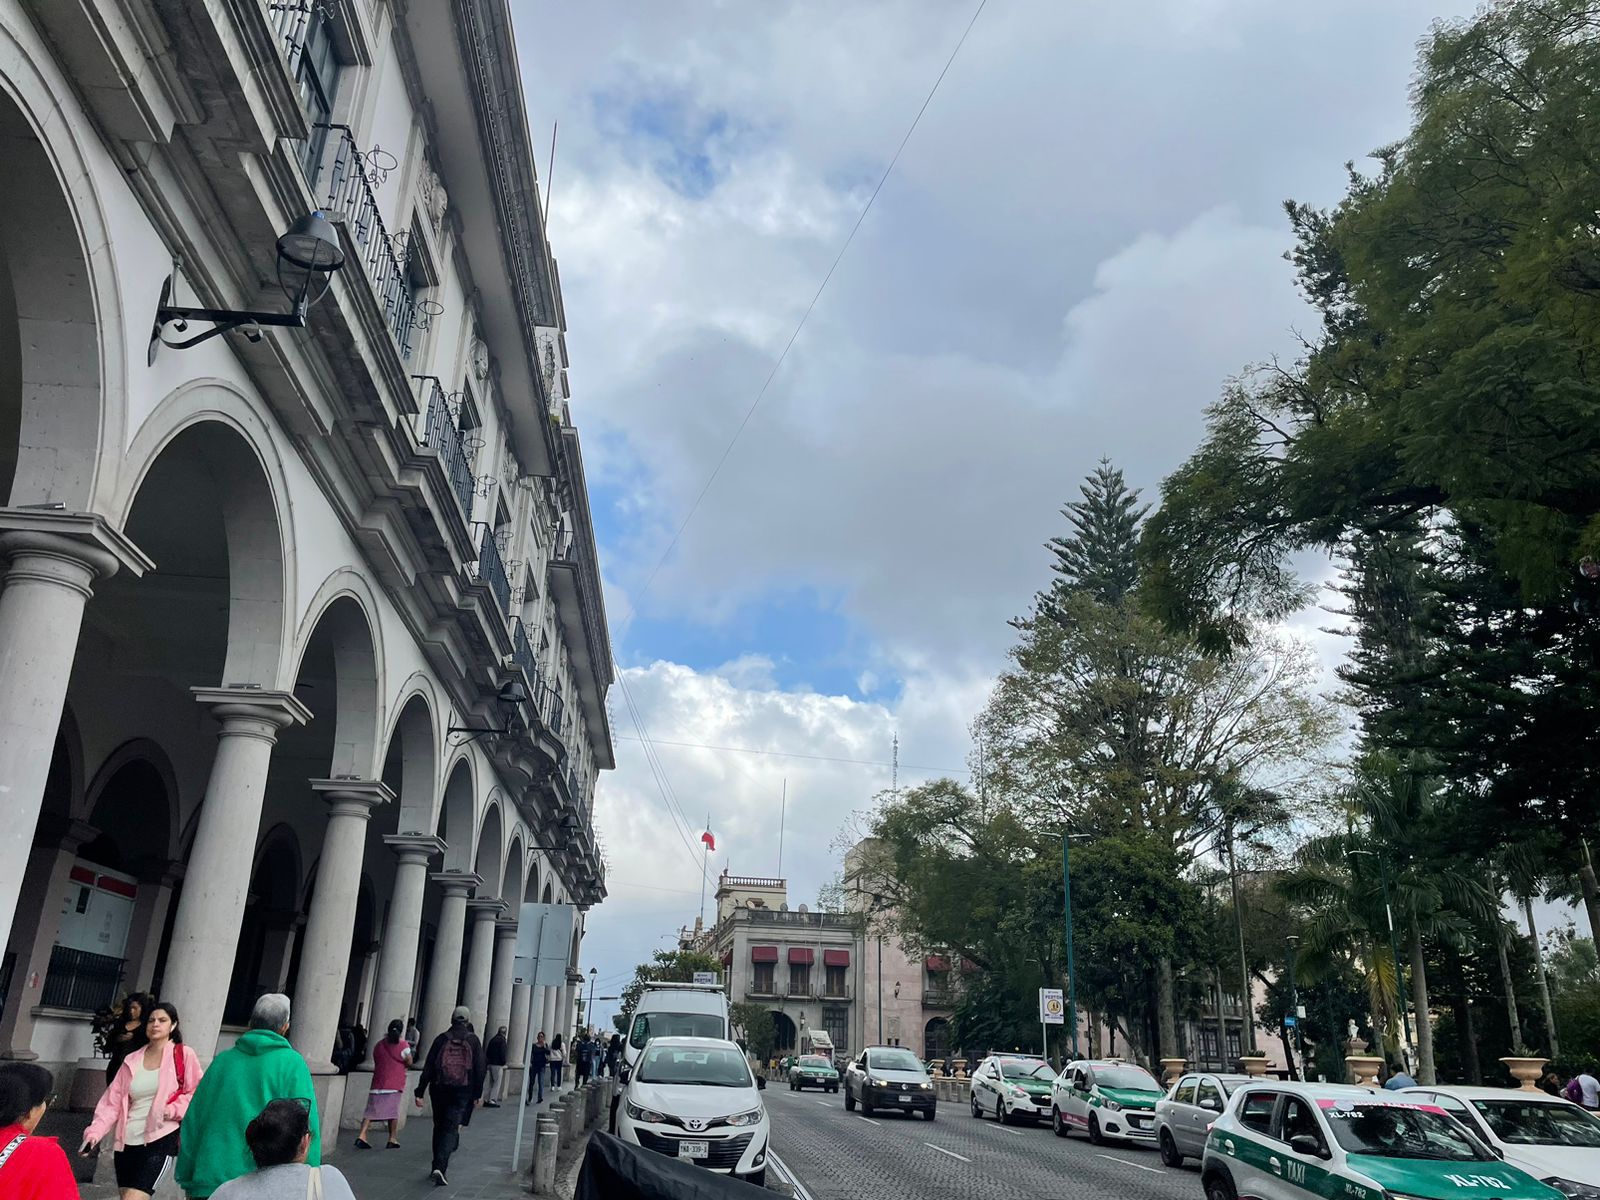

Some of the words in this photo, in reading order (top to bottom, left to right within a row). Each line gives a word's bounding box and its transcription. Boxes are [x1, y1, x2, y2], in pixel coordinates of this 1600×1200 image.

[1328, 1111, 1365, 1119] XL-782
[1287, 1159, 1306, 1184] TAXI
[1443, 1174, 1512, 1190] XL-782
[1345, 1182, 1367, 1199] XL-782
